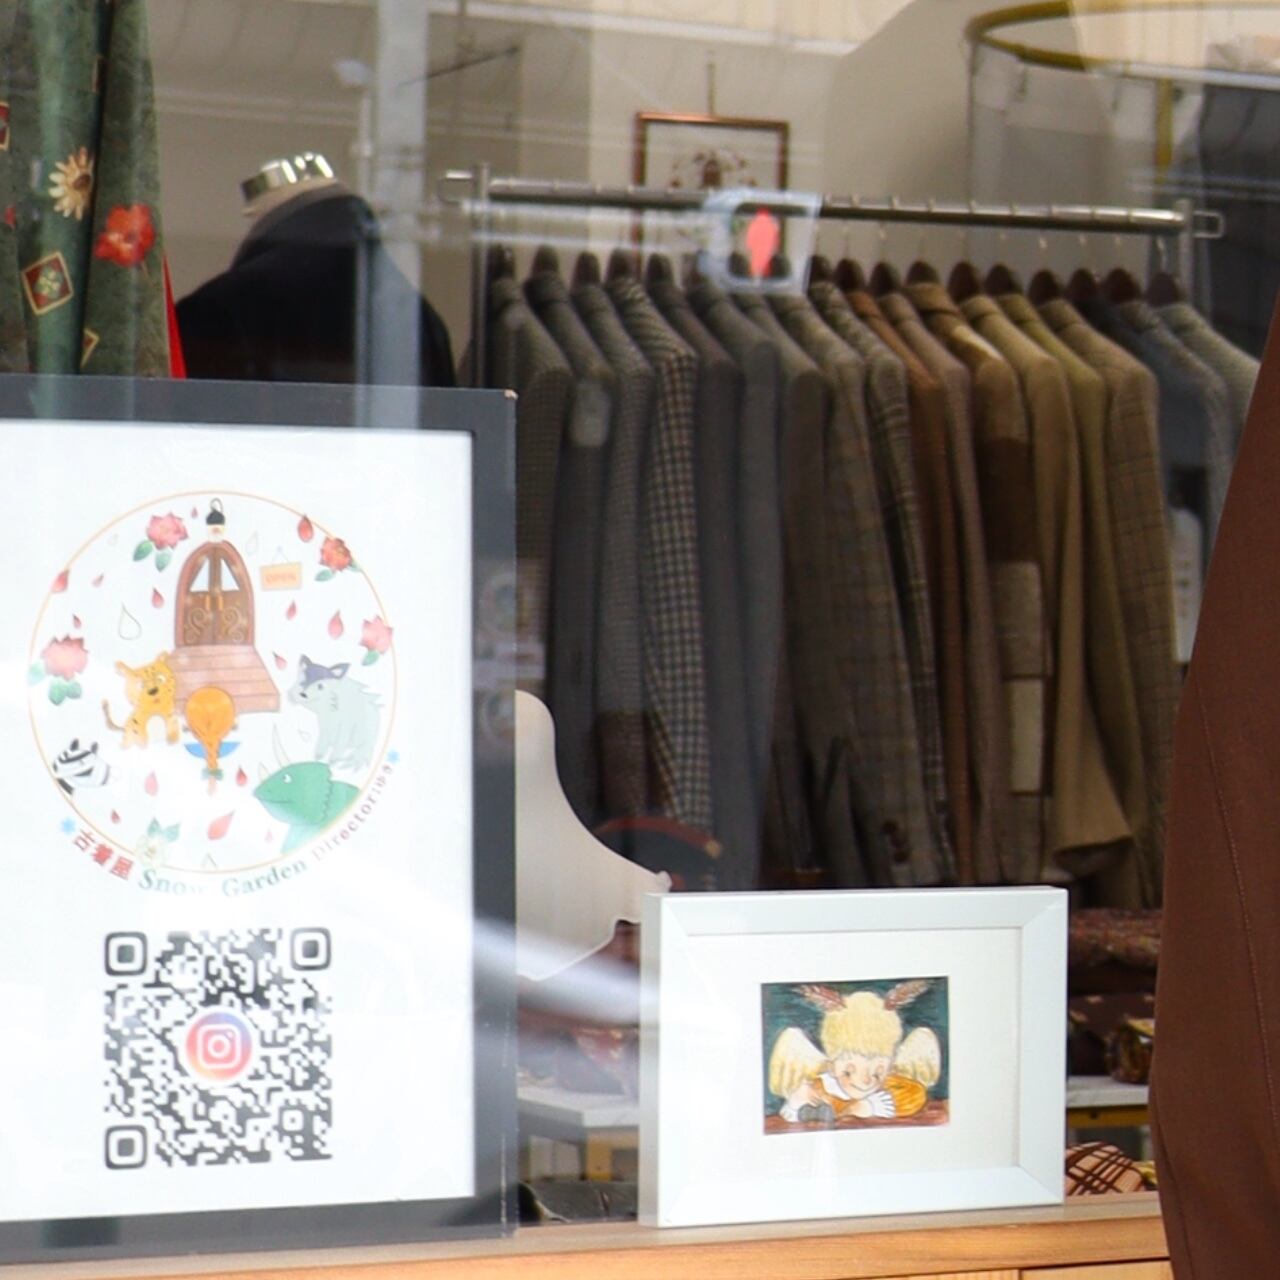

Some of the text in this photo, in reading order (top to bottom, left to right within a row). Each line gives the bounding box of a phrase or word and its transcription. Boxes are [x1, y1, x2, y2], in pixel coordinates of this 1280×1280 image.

[73, 828, 134, 881] 古着屋
[221, 858, 309, 899] Garden
